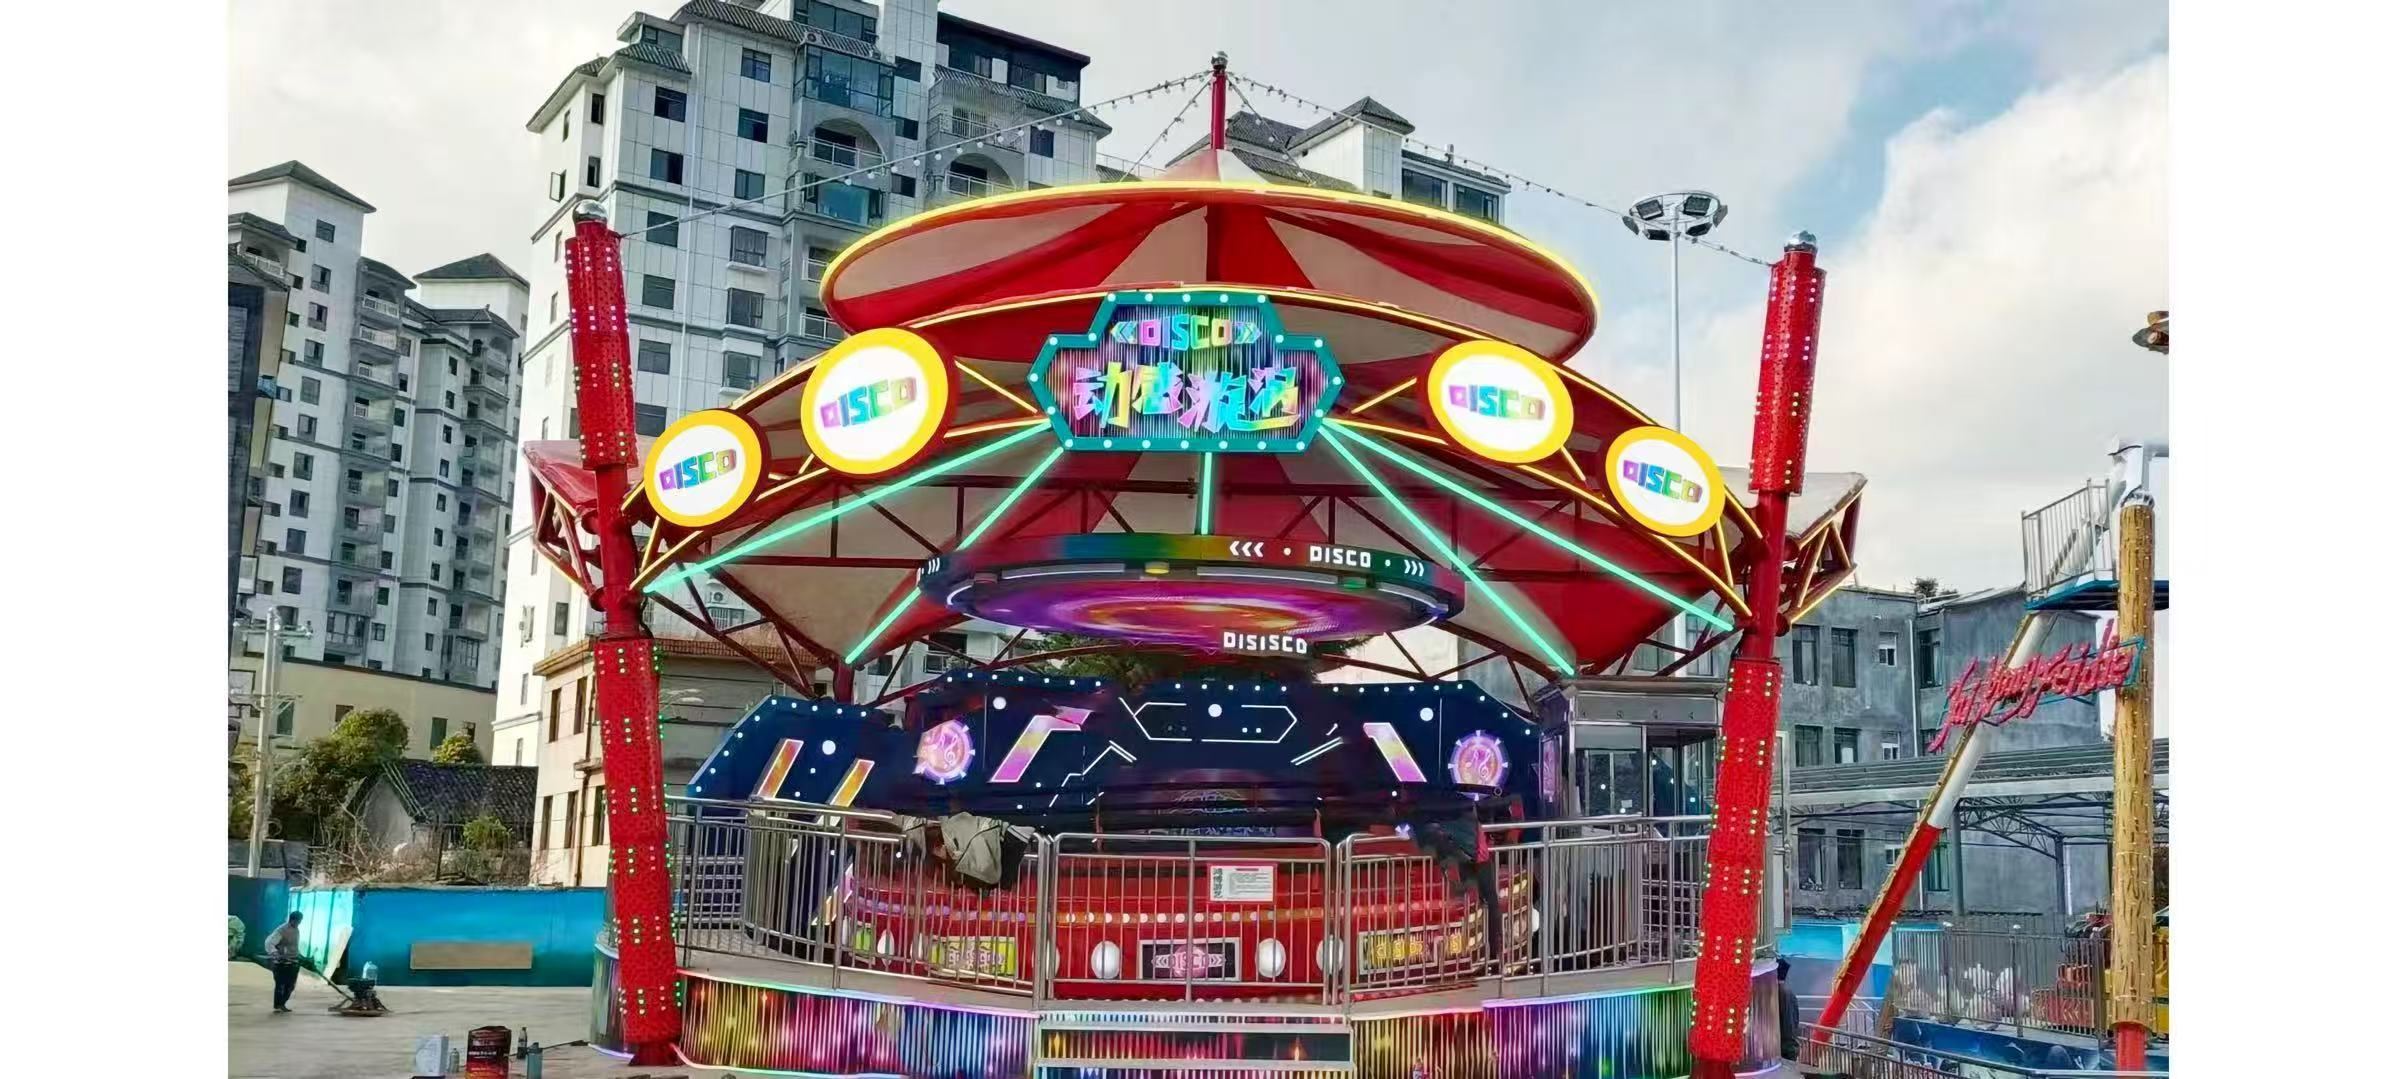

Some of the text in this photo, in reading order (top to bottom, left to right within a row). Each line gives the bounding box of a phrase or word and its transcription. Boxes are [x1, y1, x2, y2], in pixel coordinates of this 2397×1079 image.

[1139, 313, 1233, 350] DISCO
[820, 377, 917, 429] DISCO
[1448, 384, 1546, 420] DISCO
[659, 448, 737, 491] DISCO
[1623, 459, 1703, 503] DISCO
[1309, 545, 1371, 568] DISCO
